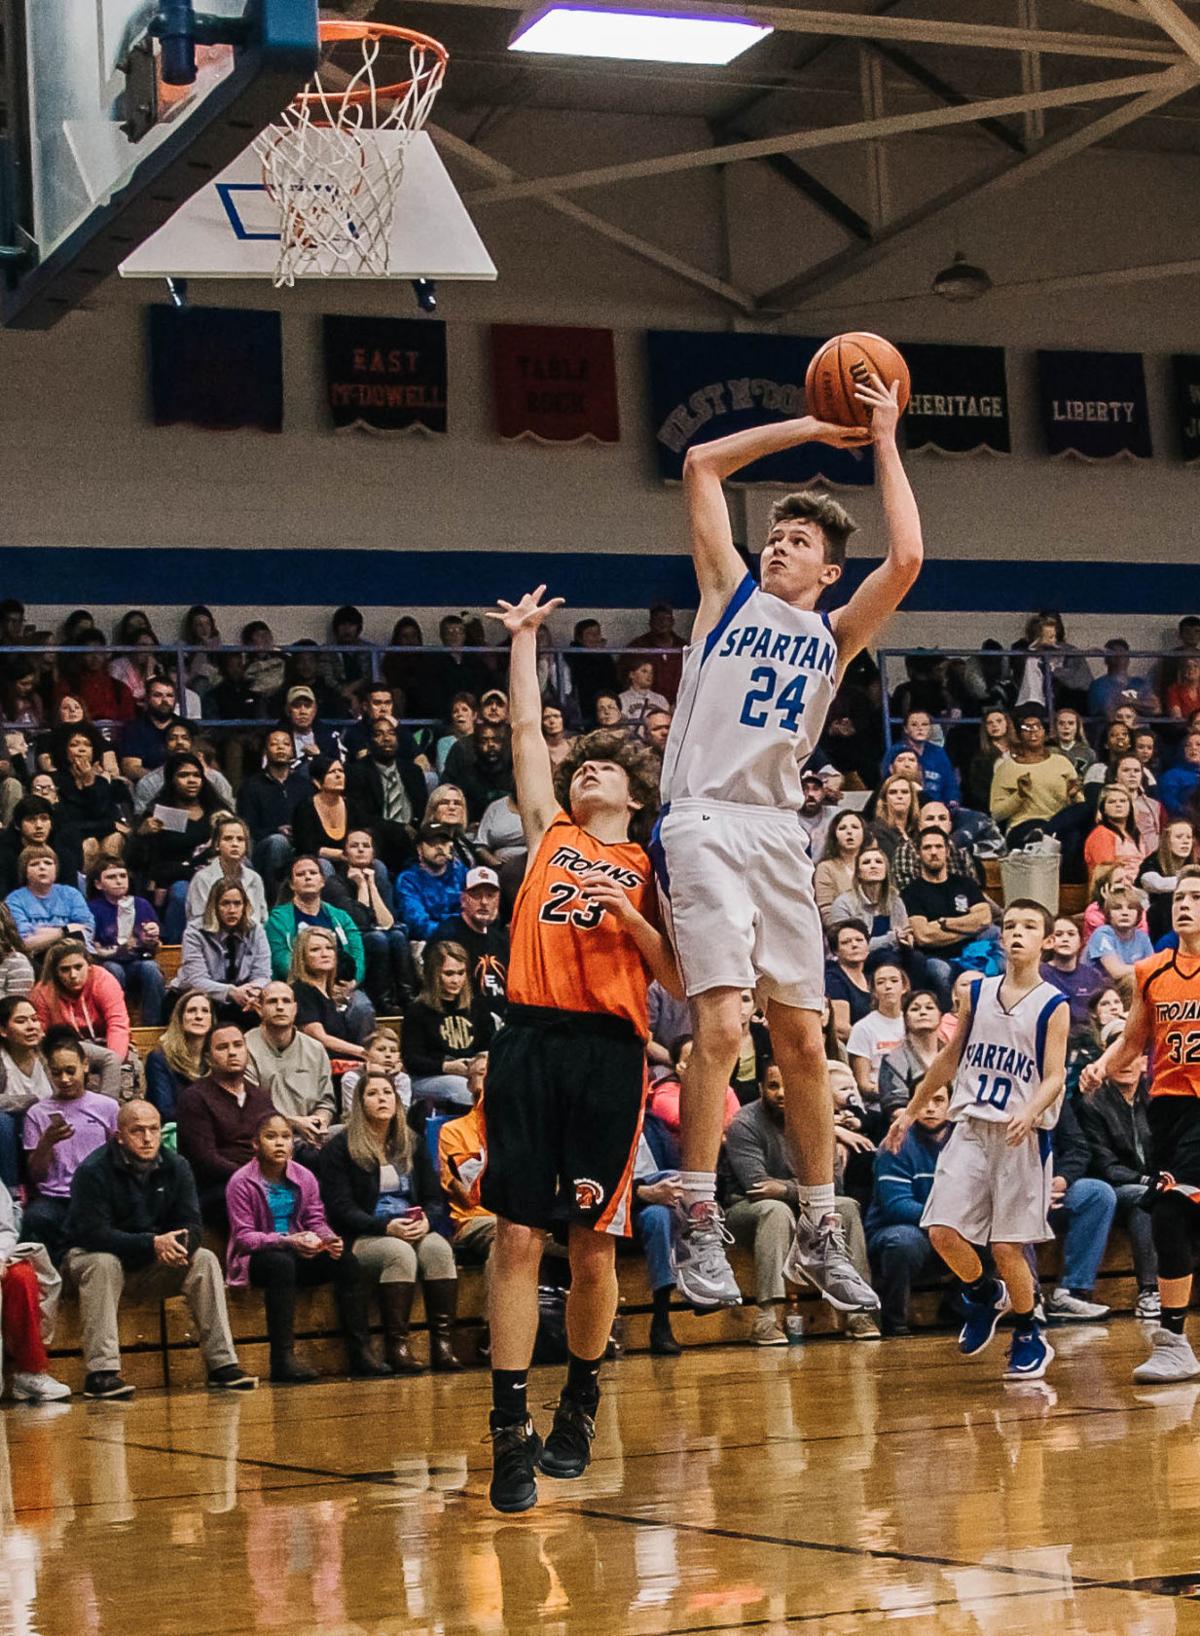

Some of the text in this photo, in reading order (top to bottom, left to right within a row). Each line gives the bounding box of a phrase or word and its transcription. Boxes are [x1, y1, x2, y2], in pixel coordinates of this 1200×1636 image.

[353, 348, 418, 373] EAST
[656, 382, 727, 454] WEST
[908, 393, 1003, 418] HERITAGE
[1053, 399, 1135, 423] LIBERTY
[739, 666, 809, 733] 24
[539, 882, 608, 931] 23
[1155, 1001, 1200, 1023] TROJA
[1166, 1031, 1200, 1066] 32
[975, 1073, 1012, 1112] 10
